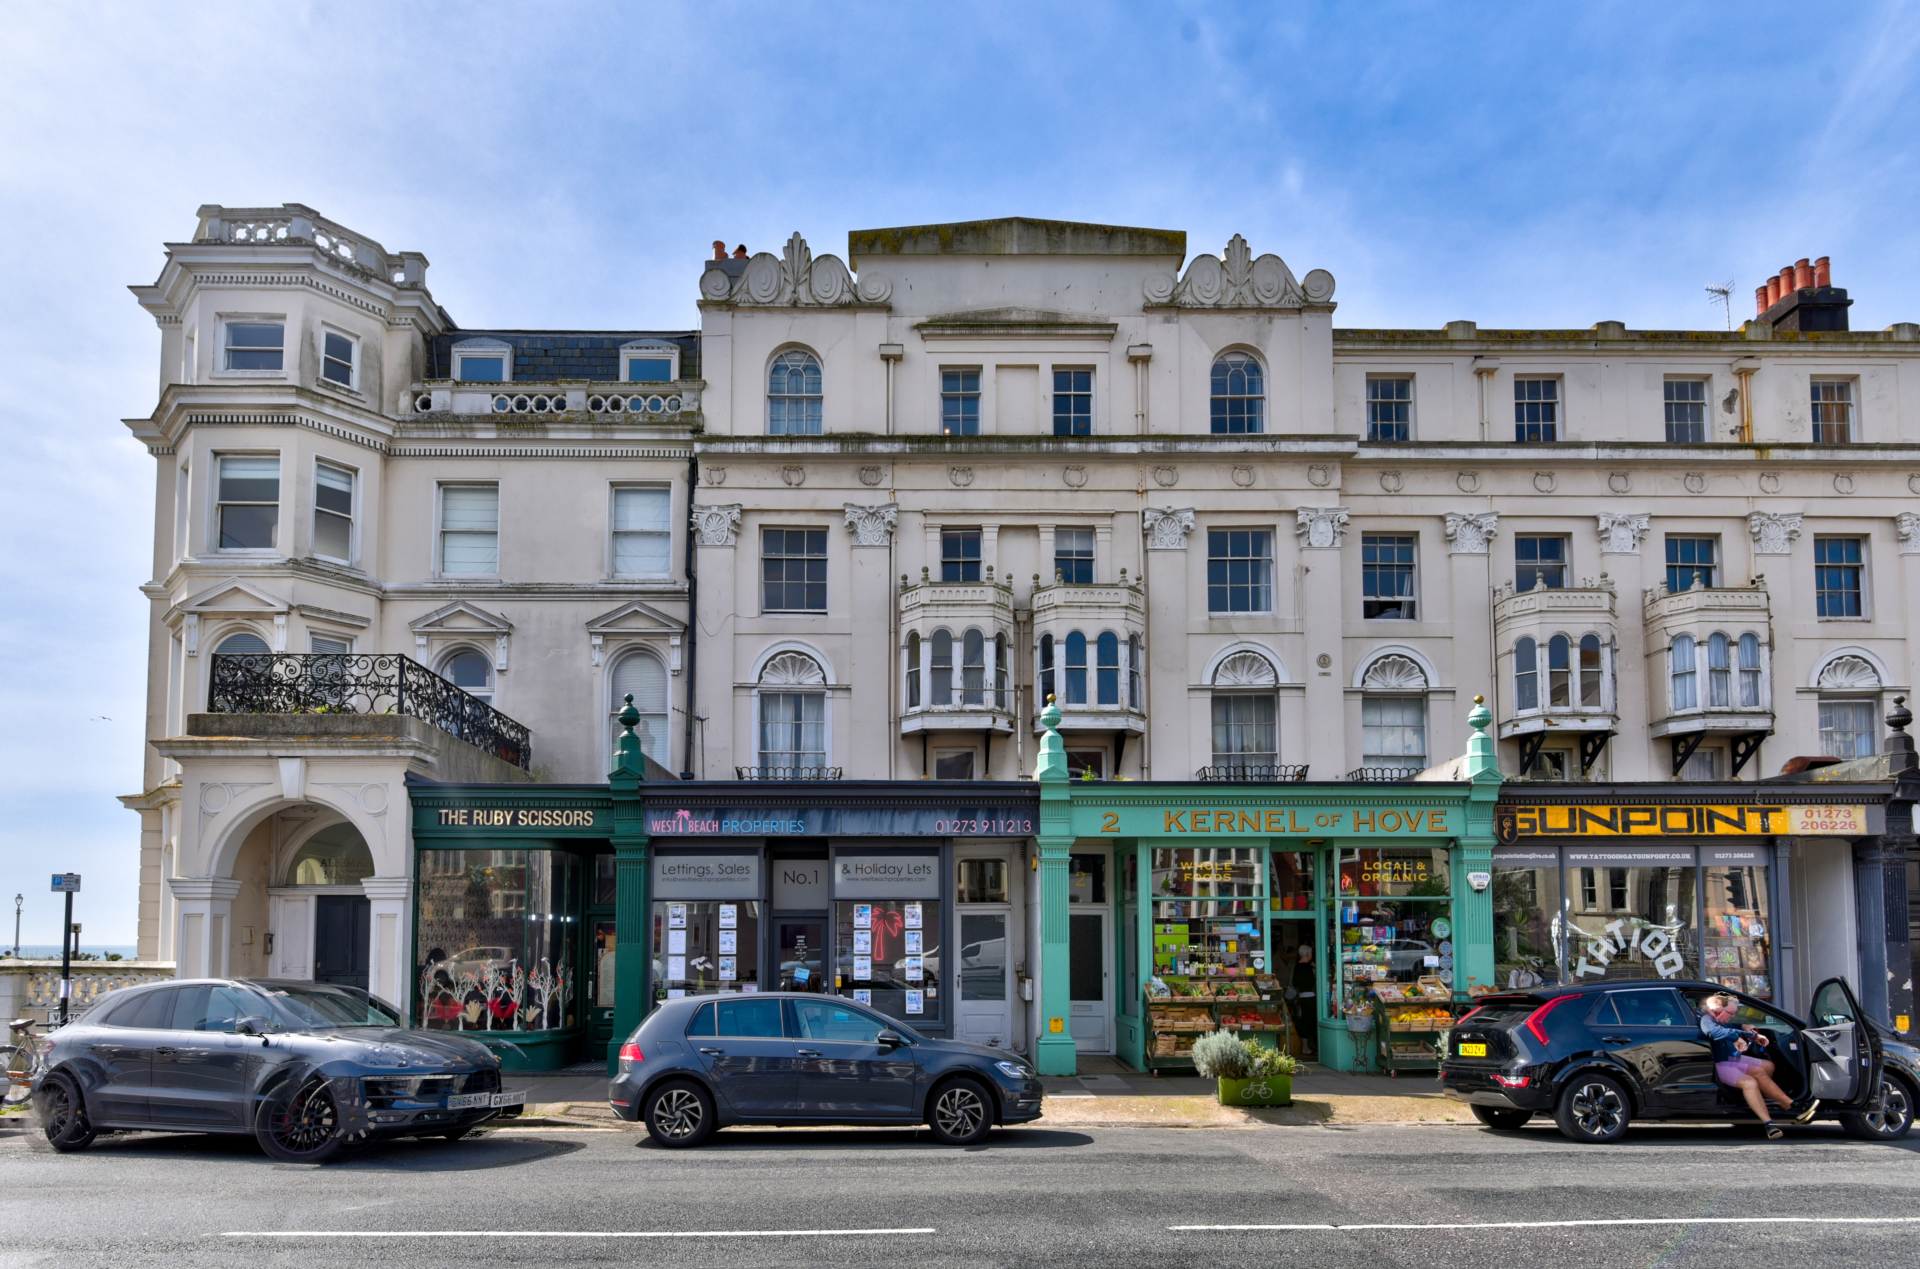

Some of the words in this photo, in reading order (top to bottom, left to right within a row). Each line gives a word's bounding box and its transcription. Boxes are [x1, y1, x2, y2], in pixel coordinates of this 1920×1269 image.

[438, 809, 468, 825] THE
[472, 810, 513, 826] RUBY
[518, 810, 594, 827] SCISSORS
[1163, 810, 1310, 833] KERNEL
[1314, 813, 1343, 828] OF
[1352, 809, 1448, 833] HOVE
[1517, 806, 1782, 834] GUNPOINT
[1804, 809, 1852, 819] 01273
[651, 820, 676, 833] WEST
[688, 820, 719, 833] BEACH
[722, 820, 805, 833] PROPERTIES
[935, 819, 977, 833] 01273
[981, 819, 1032, 833] 911213
[1101, 811, 1121, 833] 2
[1800, 820, 1857, 830] 206226
[662, 863, 714, 877] Lettings,
[718, 863, 751, 875] Sales
[841, 863, 851, 875] &
[855, 863, 903, 878] Holiday
[907, 863, 932, 875] Lets
[1180, 861, 1233, 871] WHOLE
[1363, 861, 1412, 871] LOCAL
[1416, 861, 1426, 871] &
[783, 870, 819, 885] No.1
[1183, 873, 1233, 882] FOODS
[1361, 872, 1428, 882] ORGANIC
[1576, 917, 1684, 977] TATTOO
